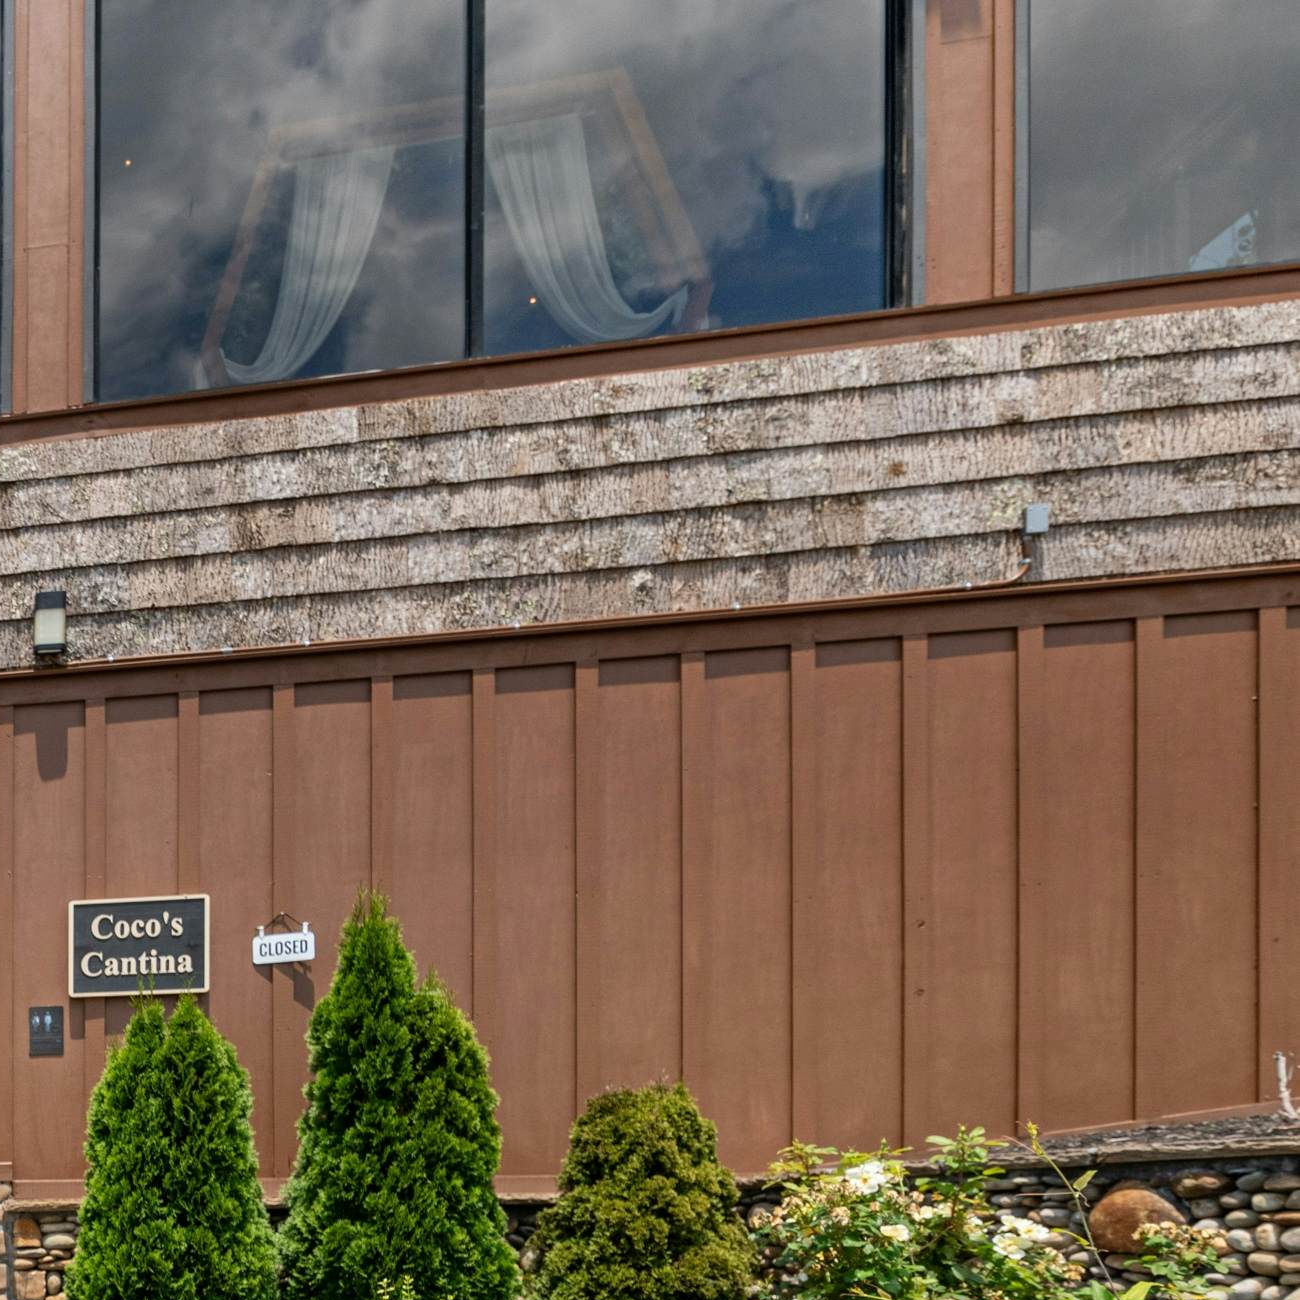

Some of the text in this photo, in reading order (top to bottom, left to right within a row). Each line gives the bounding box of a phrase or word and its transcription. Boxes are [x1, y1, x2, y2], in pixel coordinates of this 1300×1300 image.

[91, 911, 184, 940] Coco's
[259, 939, 308, 957] CLOSED
[80, 948, 193, 978] Cantina
